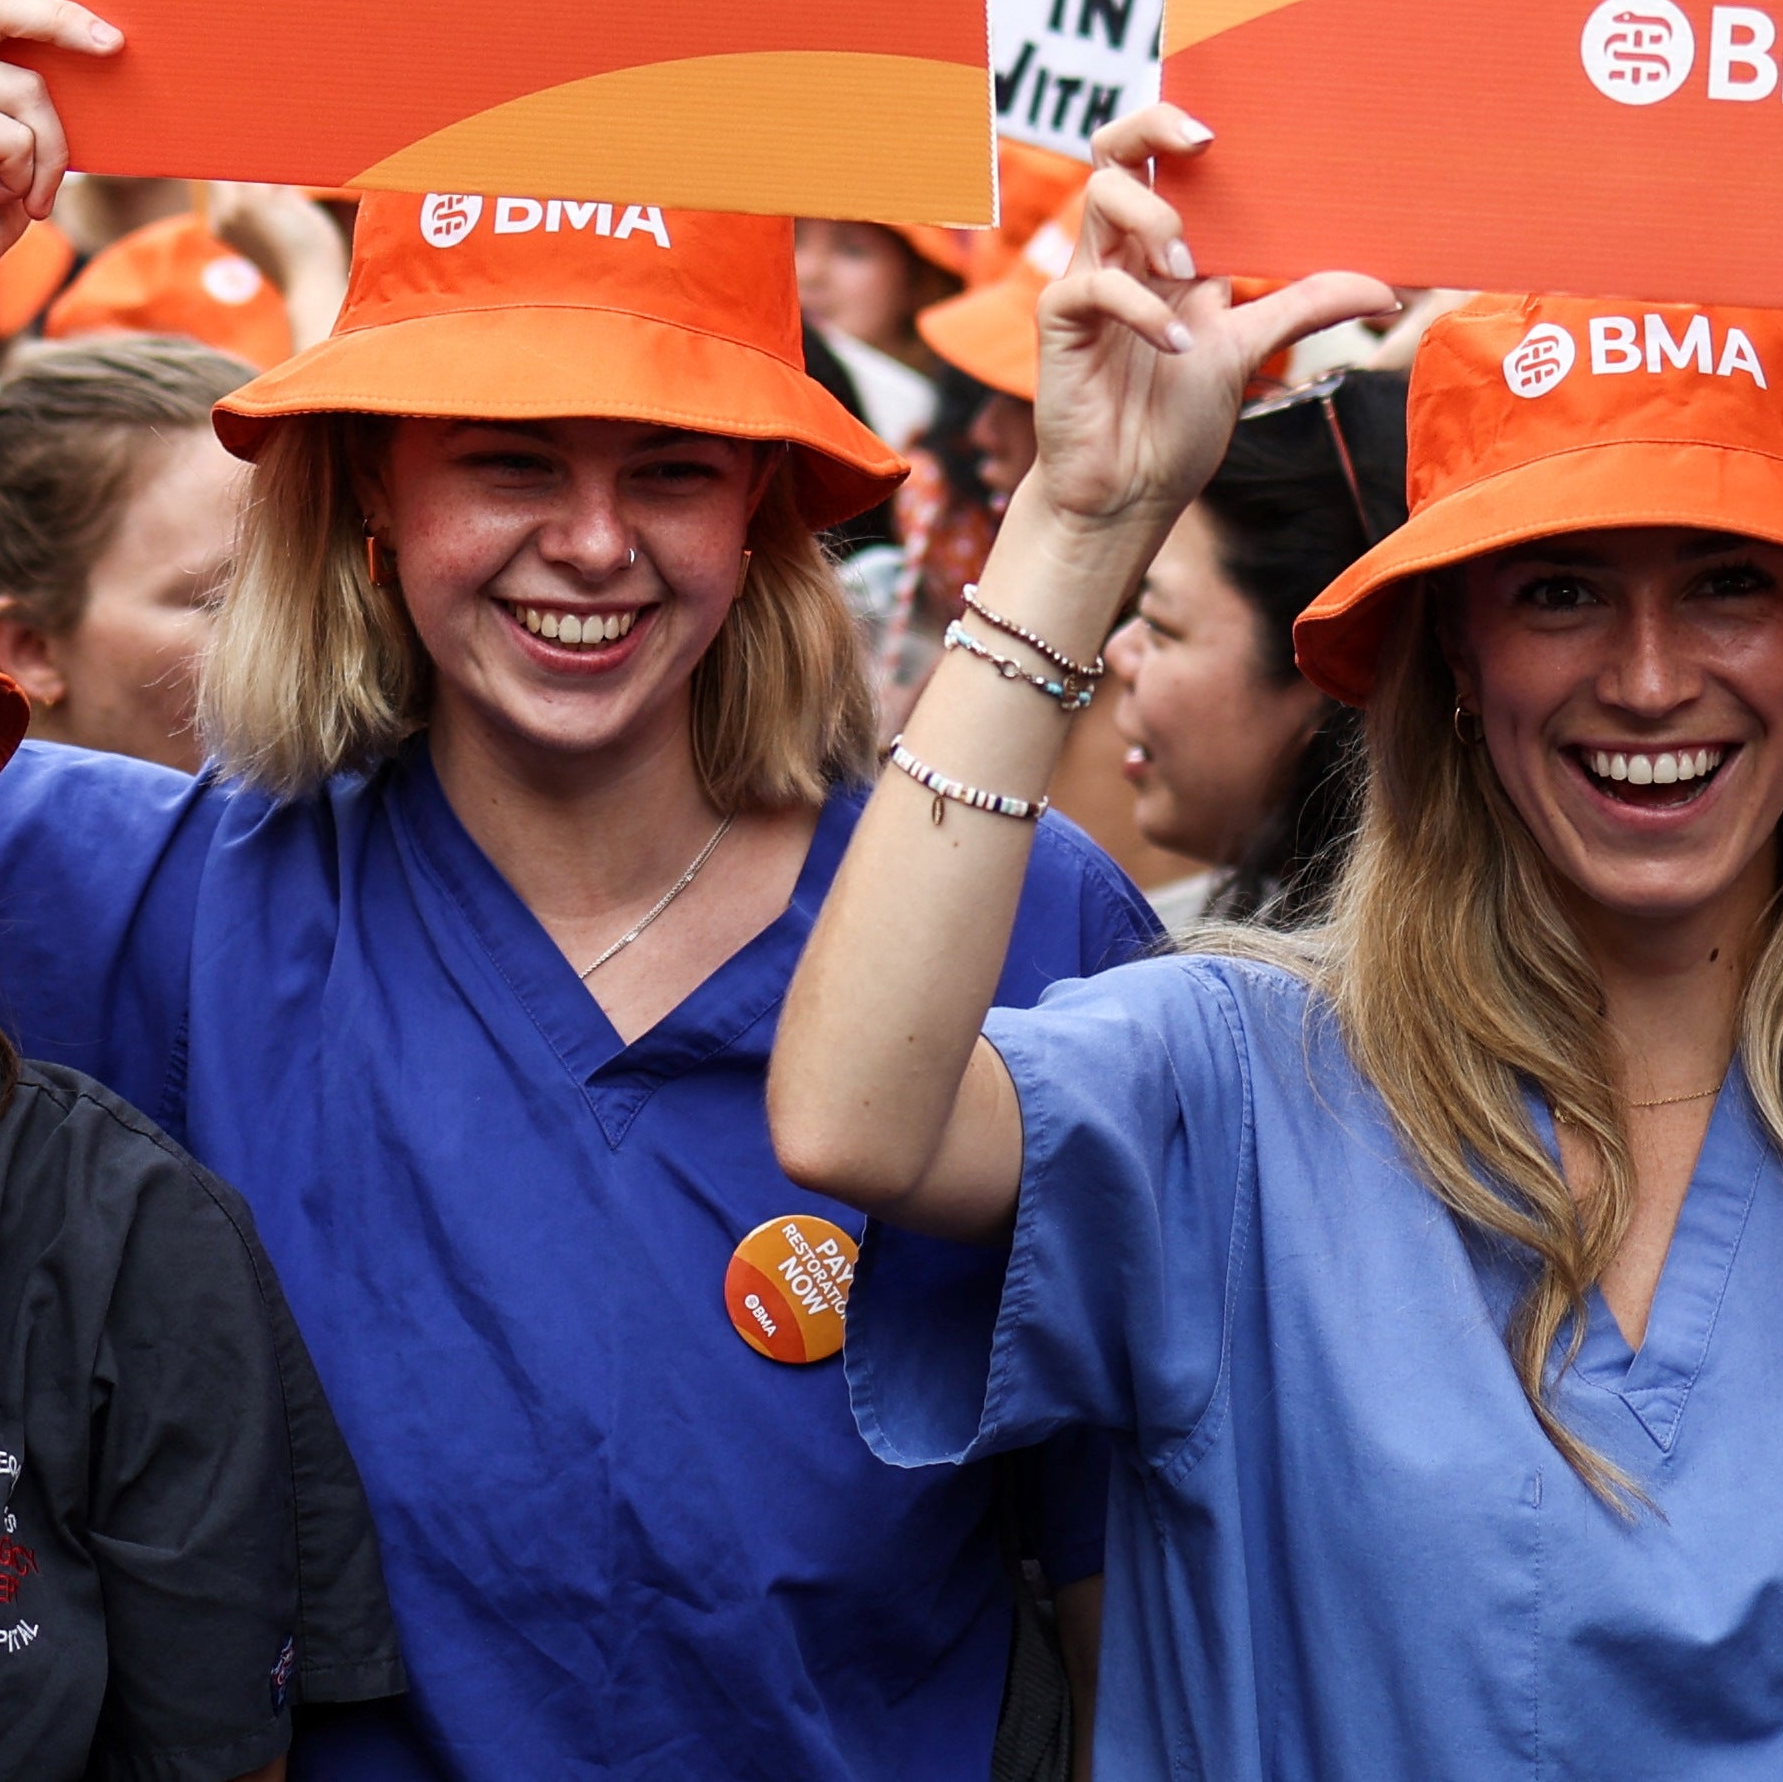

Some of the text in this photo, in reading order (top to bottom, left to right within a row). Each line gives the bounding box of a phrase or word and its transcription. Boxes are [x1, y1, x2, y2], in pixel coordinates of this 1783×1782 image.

[1588, 314, 1768, 390] BMA
[778, 1256, 829, 1316] NOW
[781, 1223, 846, 1320] RESTORATIO
[816, 1238, 854, 1285] PAY
[753, 1306, 777, 1337] BMA
